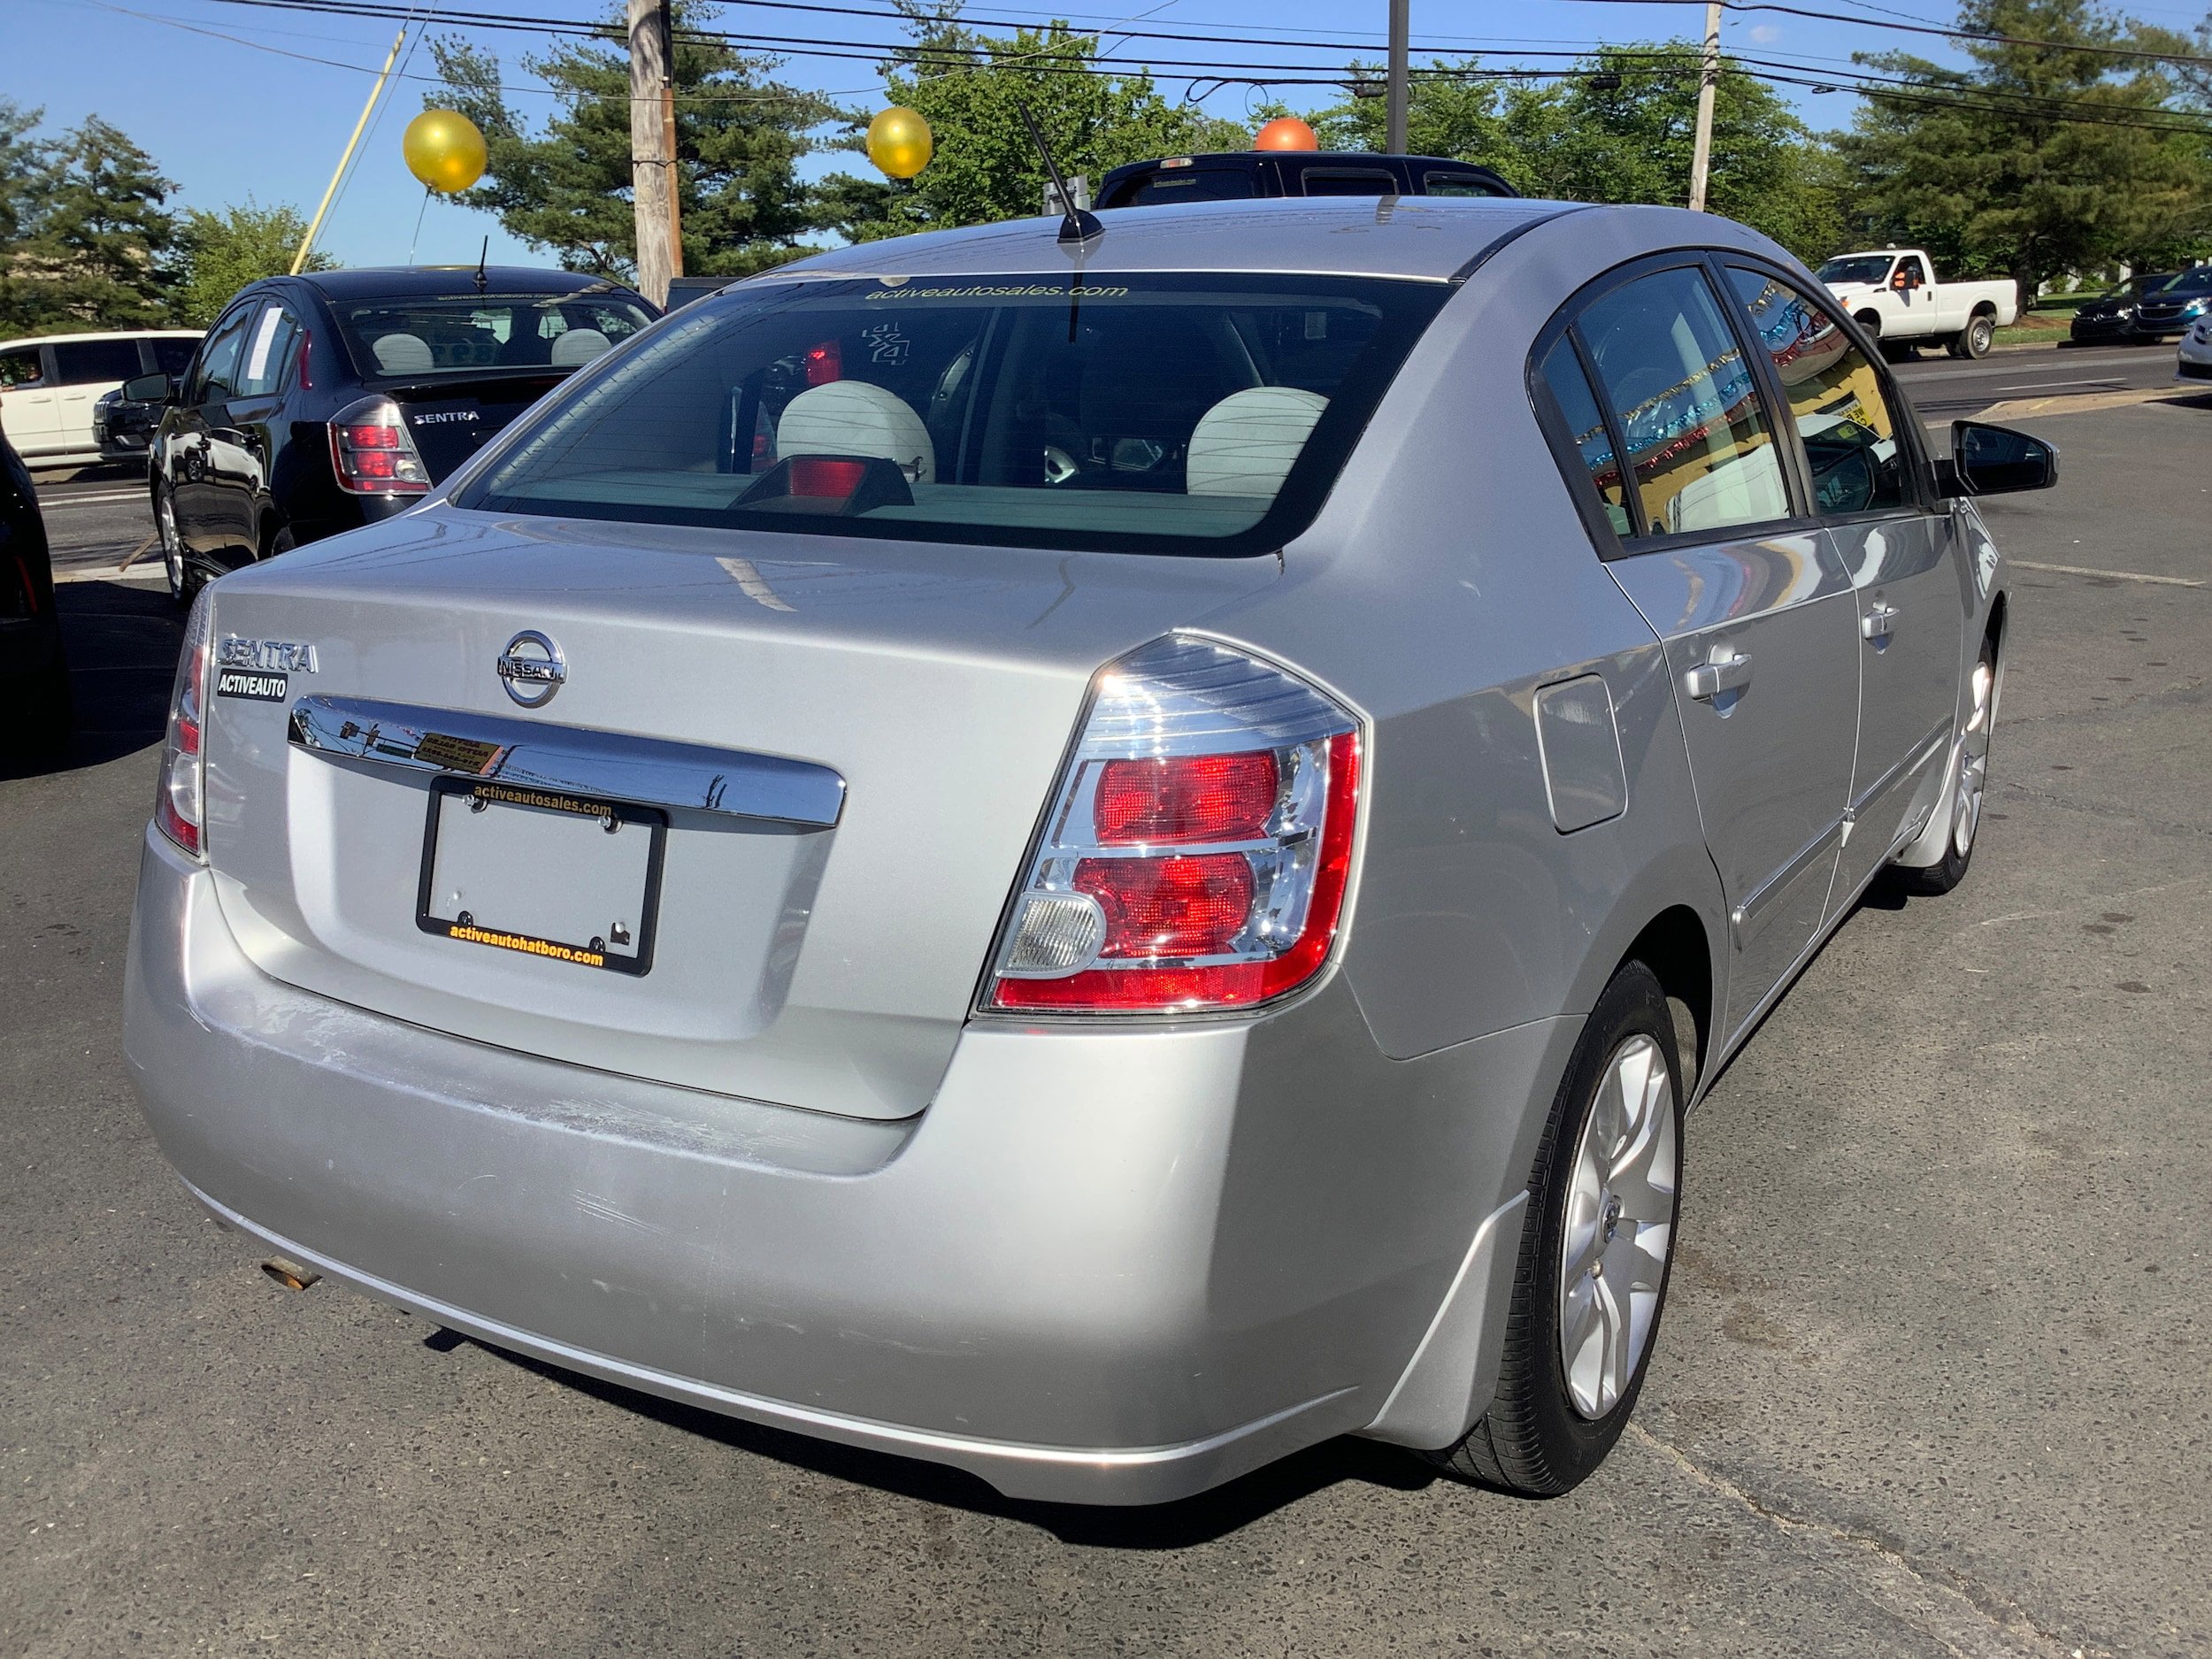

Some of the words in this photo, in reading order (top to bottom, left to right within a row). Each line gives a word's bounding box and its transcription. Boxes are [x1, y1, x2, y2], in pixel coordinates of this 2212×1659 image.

[865, 284, 1129, 300] activeautosales.com
[414, 411, 480, 425] SENTRA
[218, 639, 319, 673] SENTRA
[500, 659, 558, 680] NISSAN
[218, 674, 286, 697] ACTIVEAUTO
[474, 785, 612, 816] activeautosales.com
[449, 926, 604, 966] activeautohatboro.com
